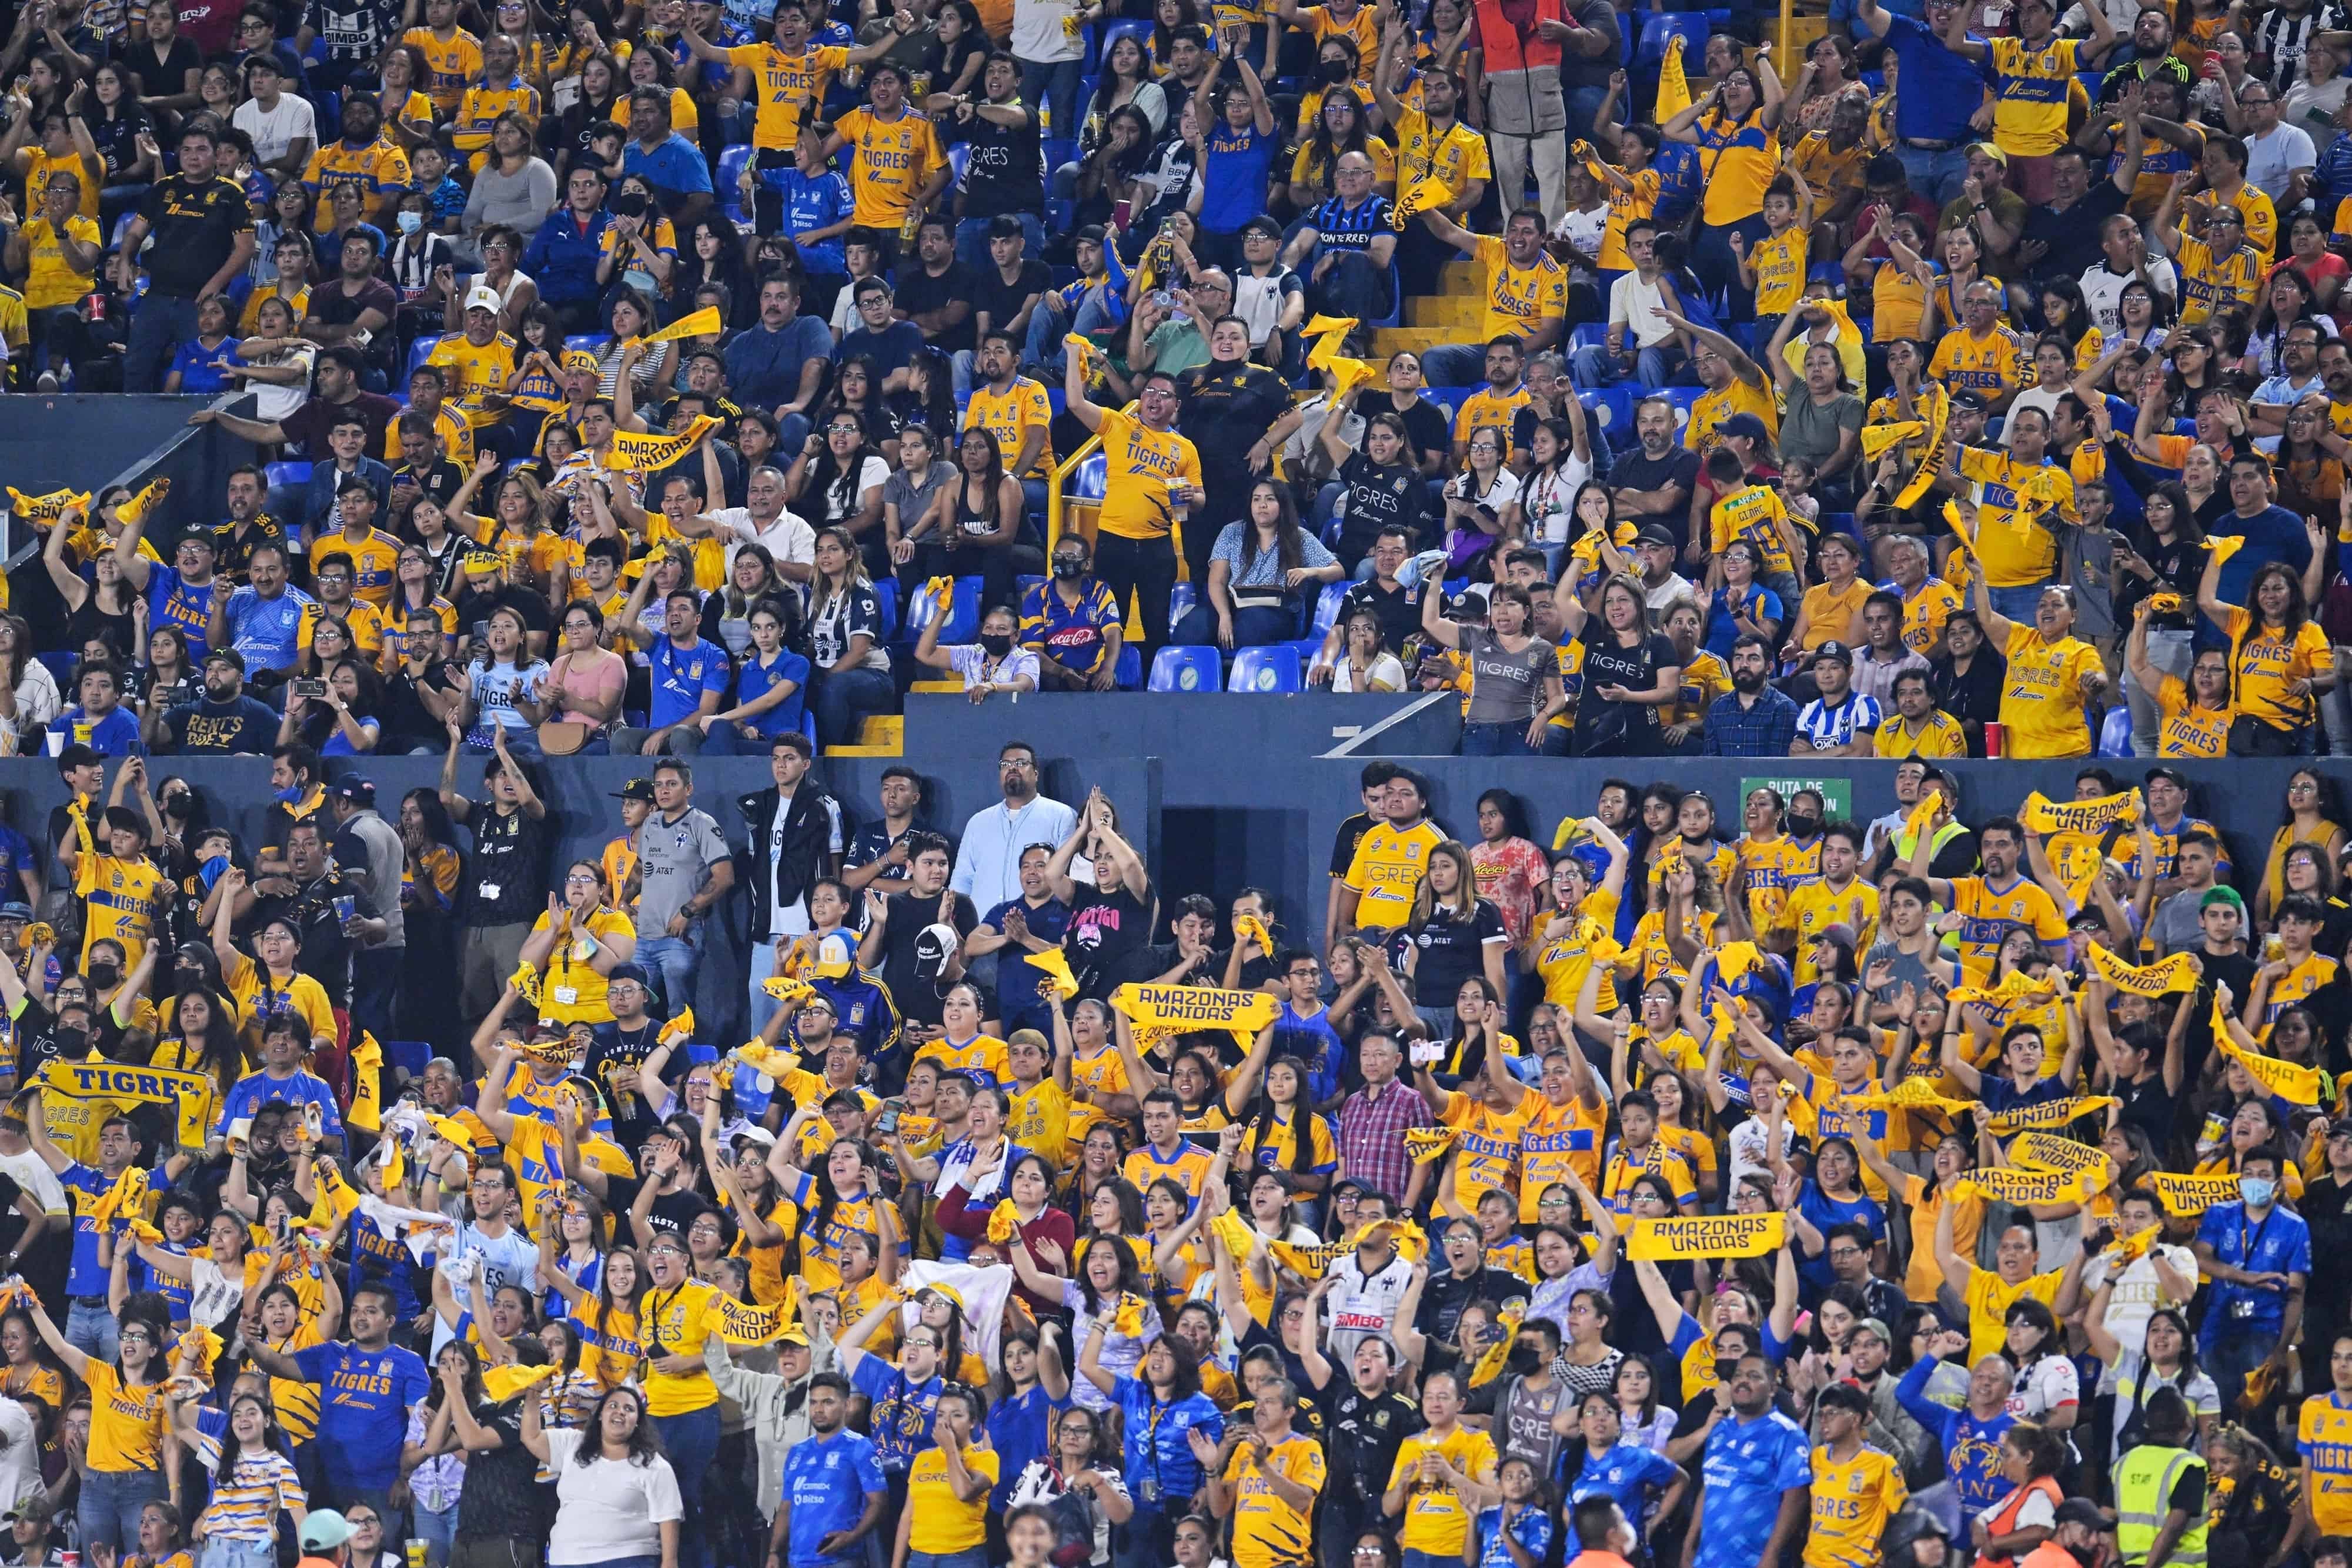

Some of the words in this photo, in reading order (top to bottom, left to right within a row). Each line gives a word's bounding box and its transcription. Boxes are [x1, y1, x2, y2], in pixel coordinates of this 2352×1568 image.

[325, 31, 369, 46] BIMBO
[767, 72, 814, 89] TIGRES
[2017, 88, 2050, 96] CEMEX
[863, 150, 909, 169] TIGRES
[970, 146, 1008, 165] GRES
[178, 210, 204, 218] CEMEX
[519, 377, 554, 394] TIGRES
[1127, 443, 1176, 474] TIGRES
[1992, 485, 2016, 506] TIG
[164, 600, 206, 627] TIGRE
[242, 643, 280, 652] CEMEX
[1478, 660, 1531, 683] TIGRES
[1591, 653, 1645, 678] TIGRES
[2019, 692, 2044, 700] CEMEX
[2167, 718, 2220, 754] TIGRES
[1769, 780, 1798, 794] RUTA
[656, 867, 674, 875] AT&T
[1376, 892, 1404, 902] CEMEX
[1434, 936, 1451, 944] AT&T
[1556, 948, 1585, 959] CEMEX
[2109, 968, 2169, 991] UNIDAS
[1140, 988, 1254, 1008] AMAZONAS
[1155, 1004, 1234, 1021] UNIDAS
[1131, 1028, 1143, 1040] TE
[604, 1044, 634, 1058] SOMOS
[640, 1044, 651, 1052] LO
[74, 1068, 195, 1098] TIGRES
[2026, 1135, 2102, 1167] AMAZONAS
[1960, 1172, 2073, 1187] AMAZONAS
[2161, 1179, 2241, 1197] AMAZON
[1655, 1218, 1766, 1236] AMAZONAS
[358, 1229, 406, 1261] TIGRES
[1672, 1235, 1749, 1252] UNIDAS
[1335, 1314, 1384, 1329] BIMBO
[330, 1370, 390, 1395] TIGRES
[109, 1398, 151, 1421] TIGRES
[344, 1400, 375, 1410] CEMEX
[803, 1495, 824, 1503] Bitso
